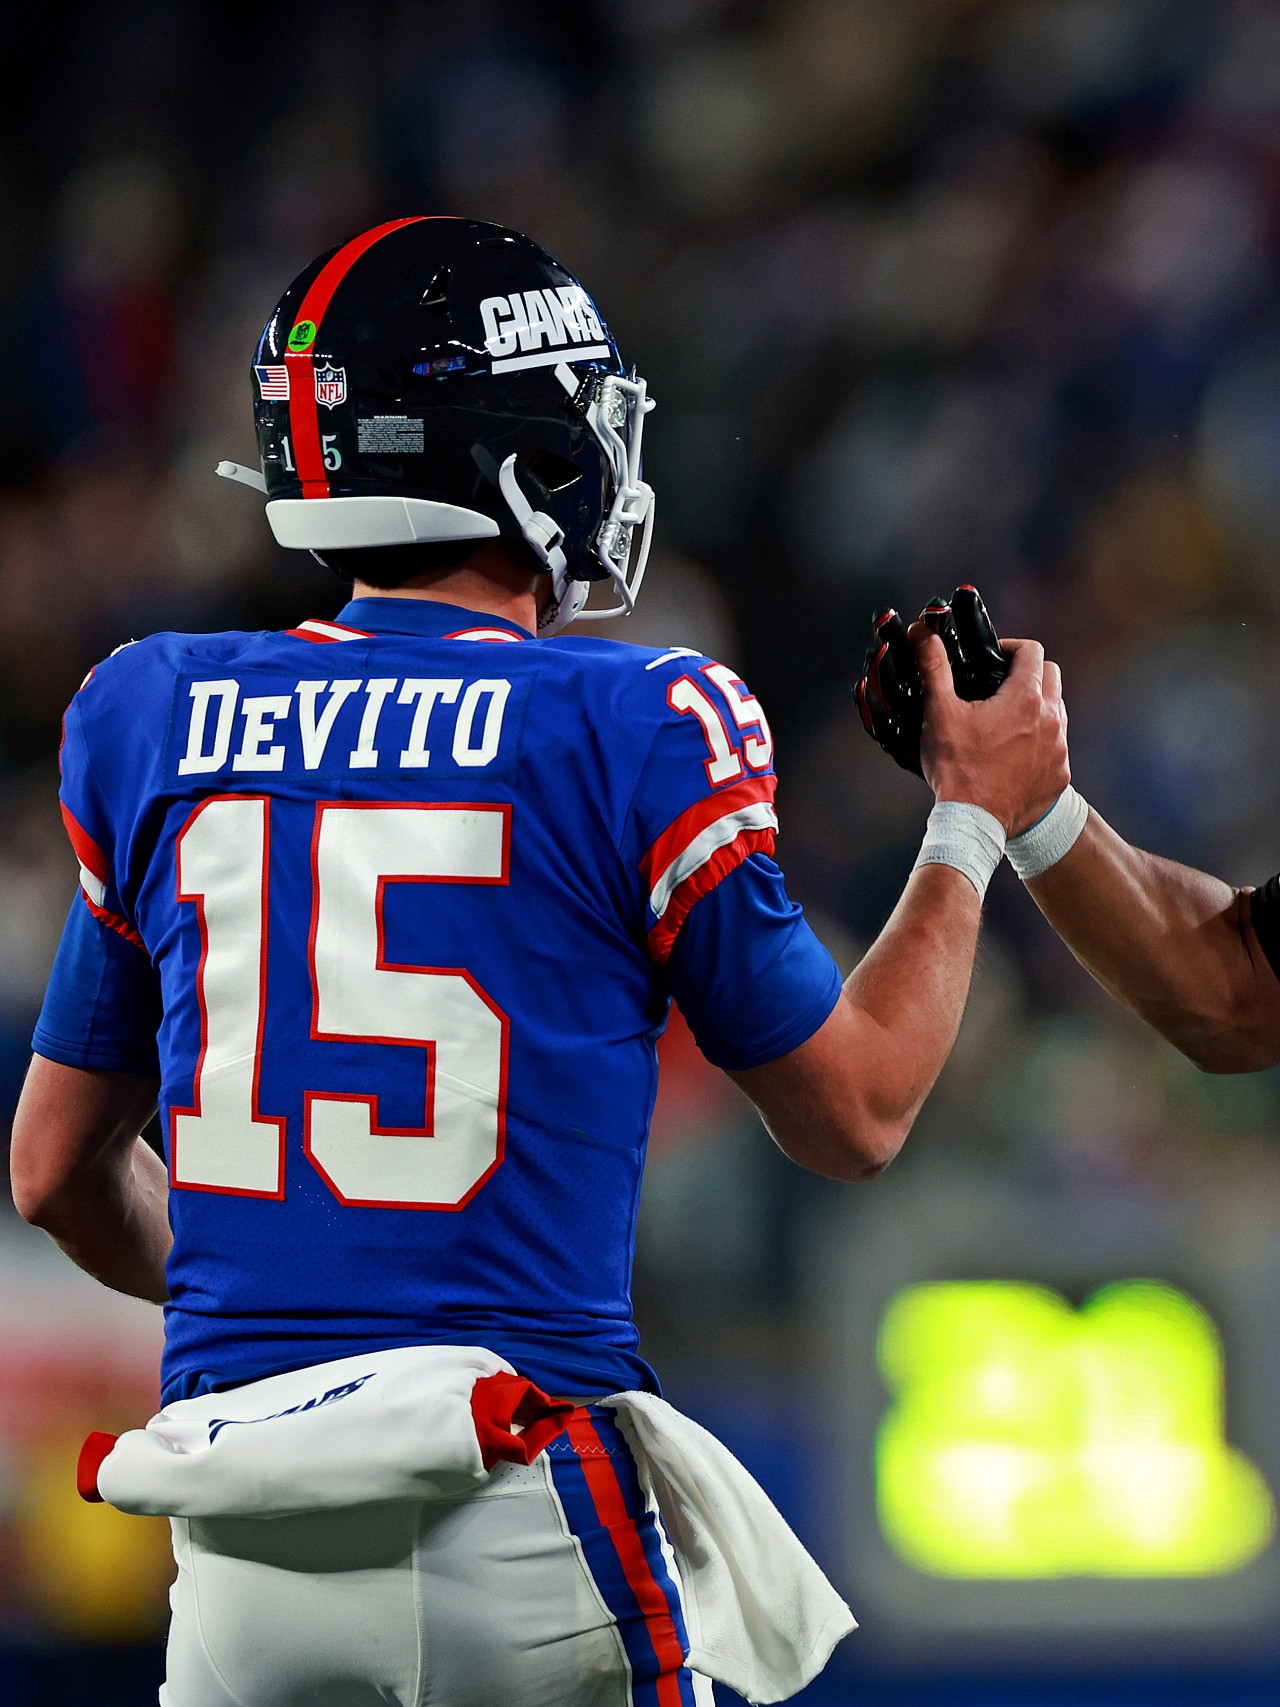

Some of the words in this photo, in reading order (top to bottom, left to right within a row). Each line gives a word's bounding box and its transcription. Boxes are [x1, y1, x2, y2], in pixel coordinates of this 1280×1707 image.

[480, 285, 605, 357] GIANTS
[319, 383, 342, 400] NFL
[666, 661, 774, 789] 15
[170, 795, 512, 1212] 15
